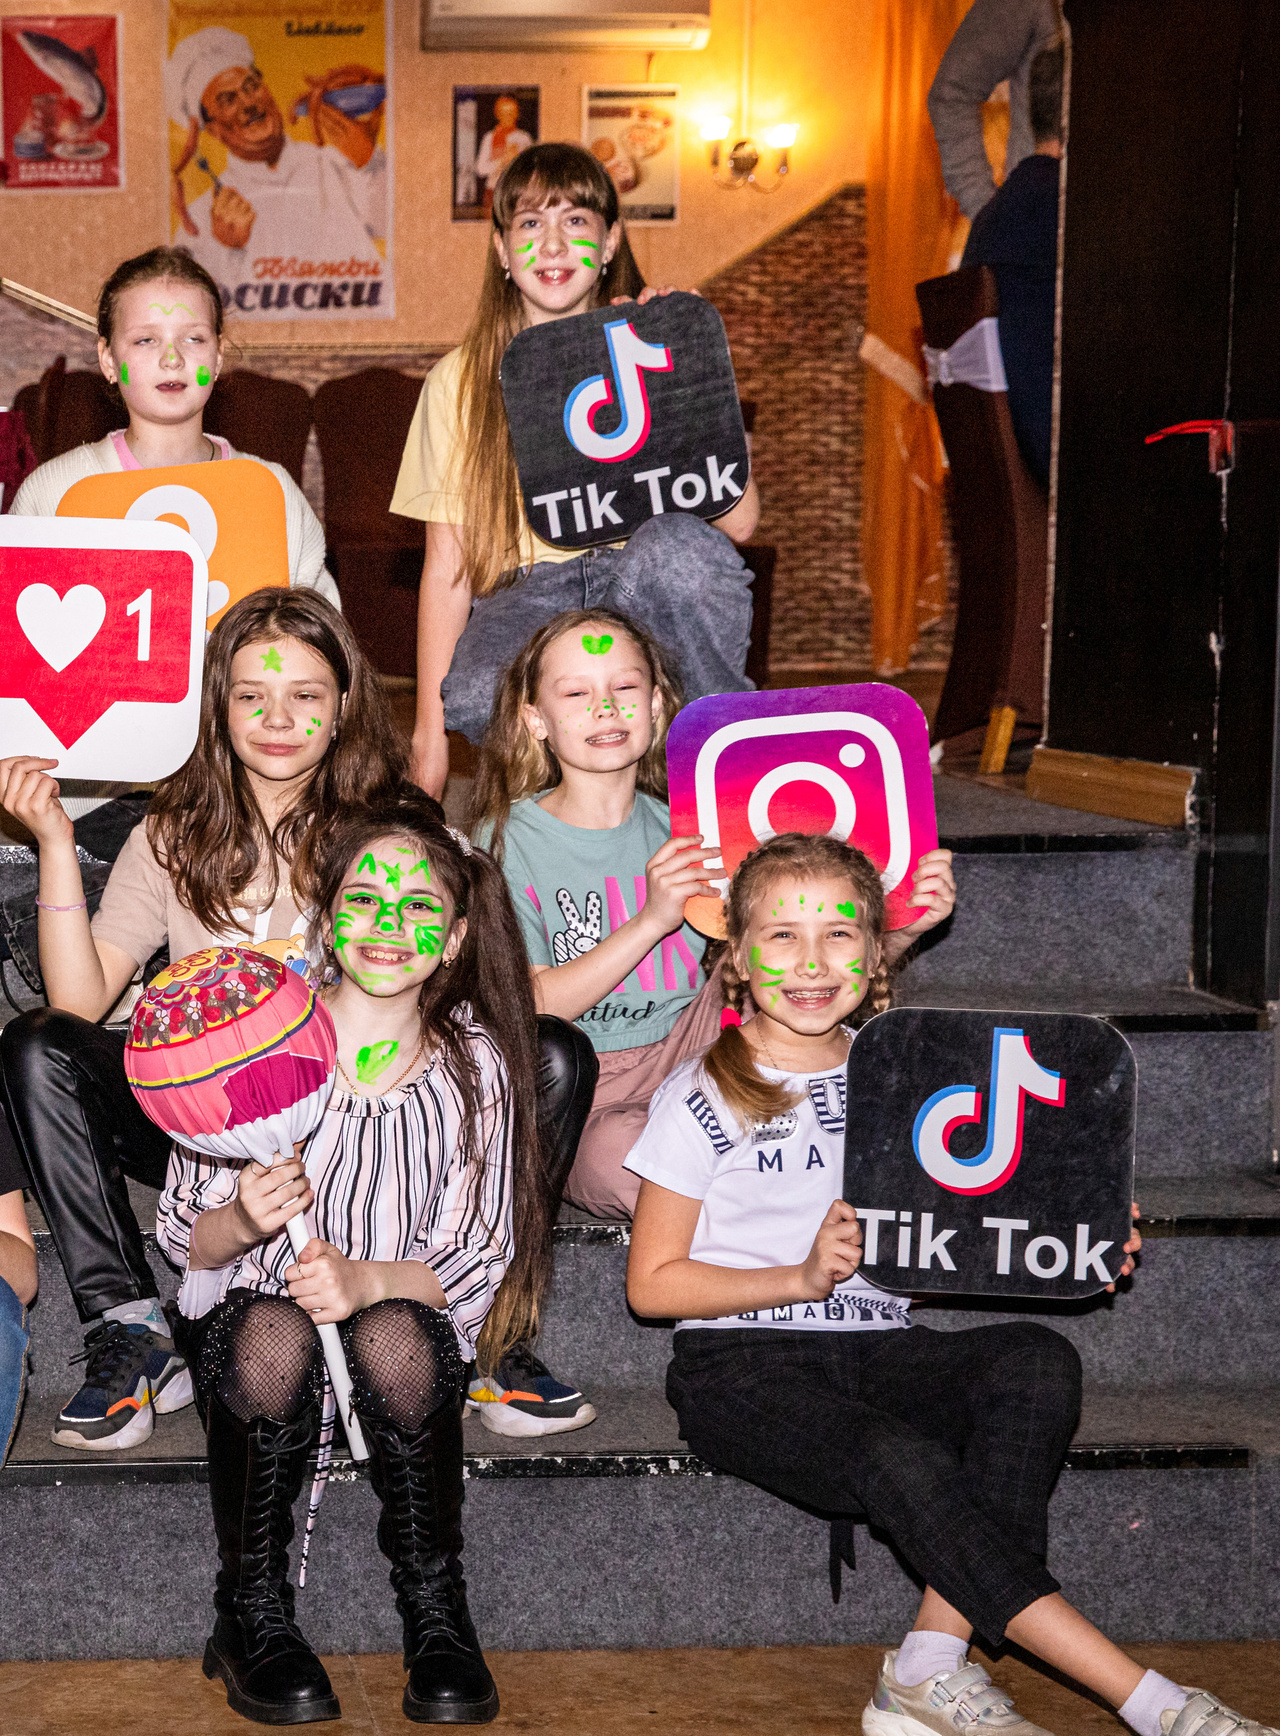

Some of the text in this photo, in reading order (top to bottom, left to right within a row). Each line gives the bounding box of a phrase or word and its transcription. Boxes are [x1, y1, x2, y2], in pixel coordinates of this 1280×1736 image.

[532, 455, 743, 539] Tik Tok
[126, 588, 152, 661] 1
[856, 1208, 1115, 1283] Tik Tok
